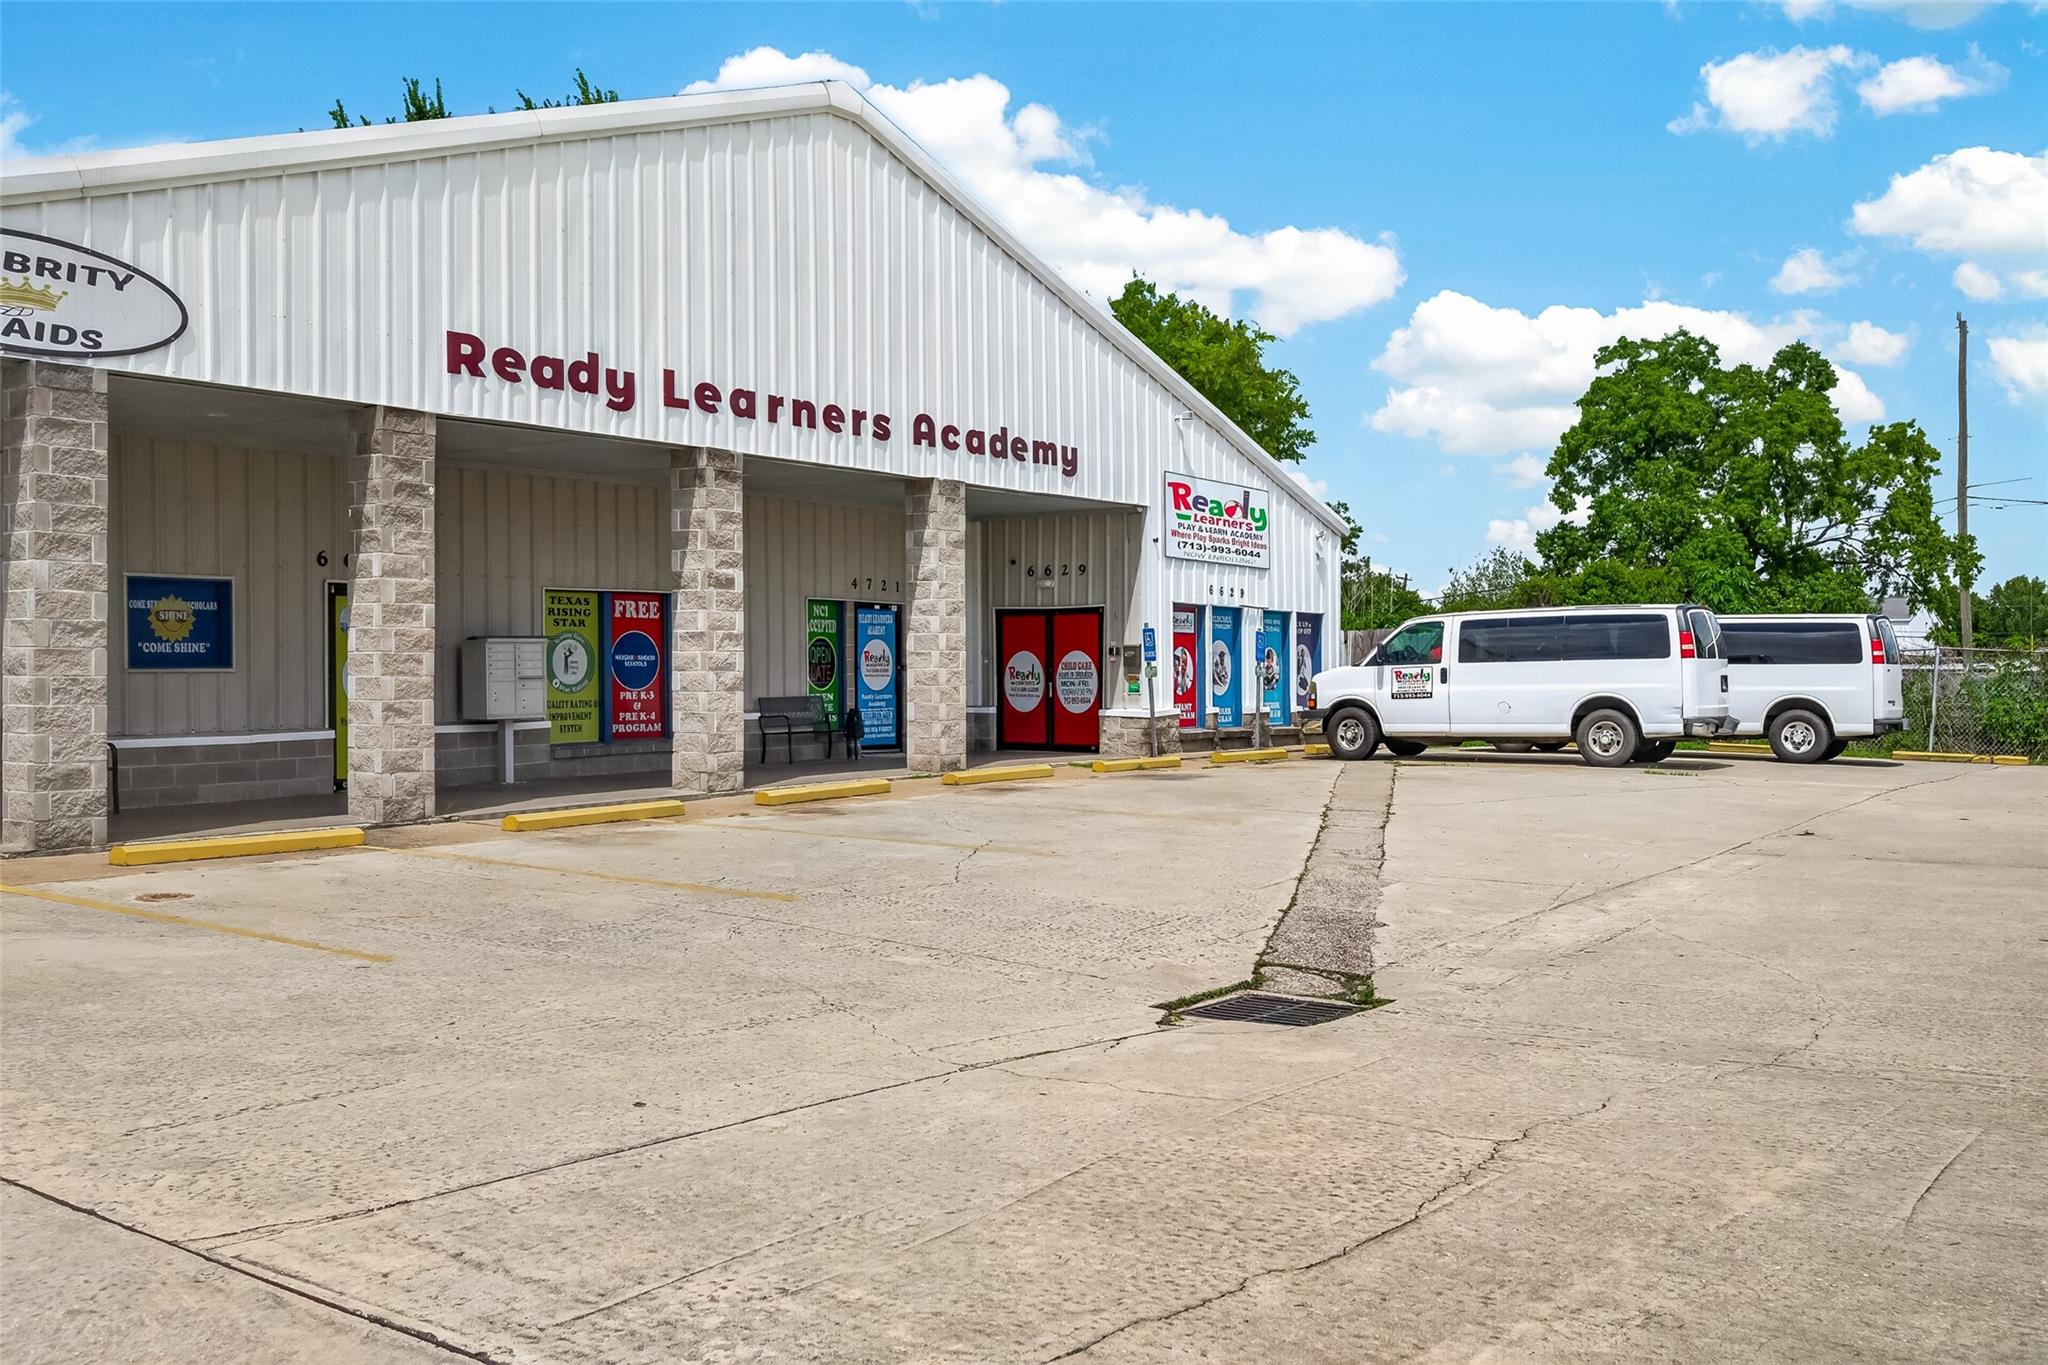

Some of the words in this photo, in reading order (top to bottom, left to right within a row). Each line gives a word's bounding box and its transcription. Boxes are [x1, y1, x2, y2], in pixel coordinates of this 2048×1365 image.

[3, 250, 135, 291] BRITY
[1, 317, 103, 350] AIDS
[446, 330, 636, 412] Ready
[663, 368, 892, 442] Learners
[913, 413, 1079, 477] Academy
[1167, 481, 1268, 532] Ready
[1193, 513, 1254, 532] Learners
[1170, 528, 1192, 540] Where
[1193, 532, 1208, 543] Play
[1208, 535, 1230, 545] Sparks
[1231, 538, 1250, 549] Bright
[1251, 542, 1268, 550] Ideas
[1178, 522, 1196, 532] PLAY
[1205, 527, 1228, 536] LEARN
[1230, 530, 1264, 541] ACADEMY
[1177, 541, 1261, 558] (713)-993-6044
[1183, 551, 1206, 560] NOW
[550, 595, 591, 606] TEXAS
[548, 607, 592, 617] RISING
[614, 600, 660, 619] FREE
[813, 604, 829, 617] NCI
[553, 618, 587, 628] STAR
[808, 619, 837, 633] CCEPTED
[138, 642, 173, 653] "COME
[173, 642, 211, 653] SHINE"
[810, 646, 832, 663] OPEN
[1394, 668, 1431, 683] Ready
[619, 691, 638, 700] PRE
[619, 712, 640, 721] PRE
[612, 723, 662, 732] PROGRAM
